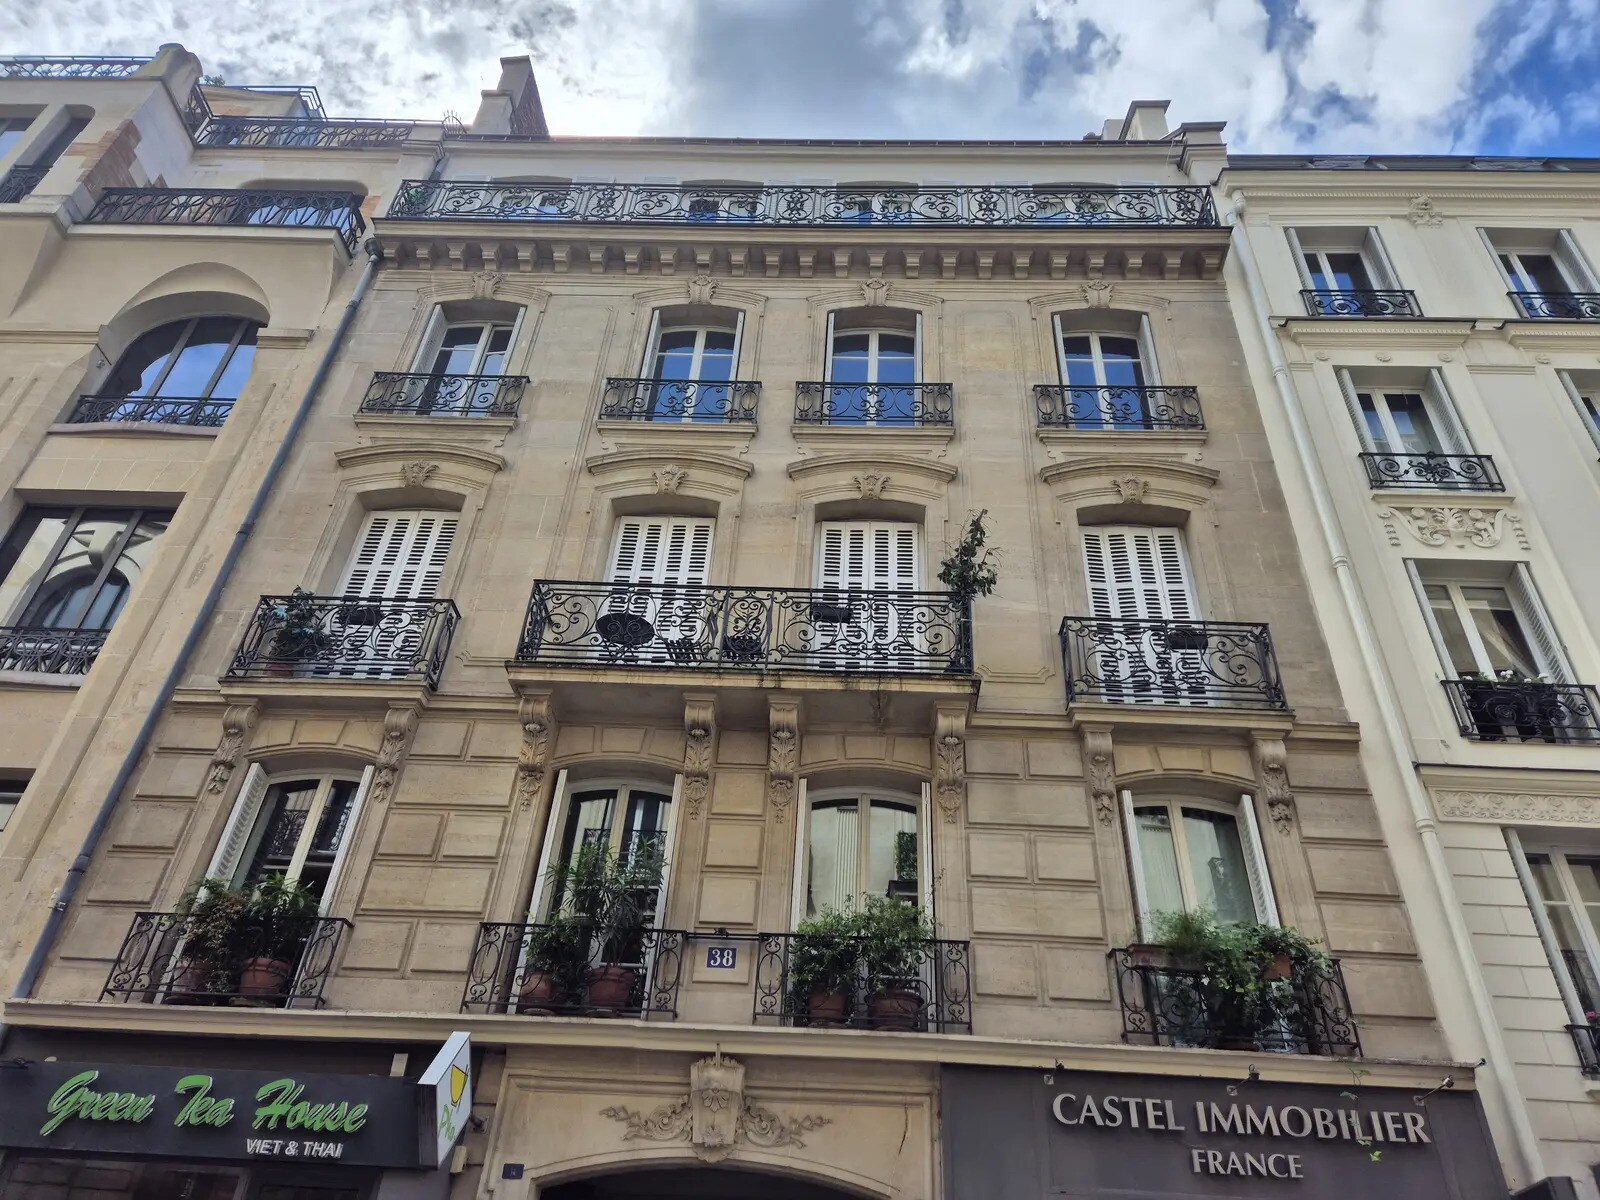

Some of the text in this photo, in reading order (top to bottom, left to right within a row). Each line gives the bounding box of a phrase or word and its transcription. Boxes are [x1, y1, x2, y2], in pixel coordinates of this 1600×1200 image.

[710, 948, 733, 966] 38
[40, 1070, 369, 1136] Green Tea House
[1052, 1093, 1432, 1143] CASTEL IMMOBILIER
[246, 1138, 344, 1159] VIET & THAI
[1191, 1148, 1304, 1179] FRANCE
